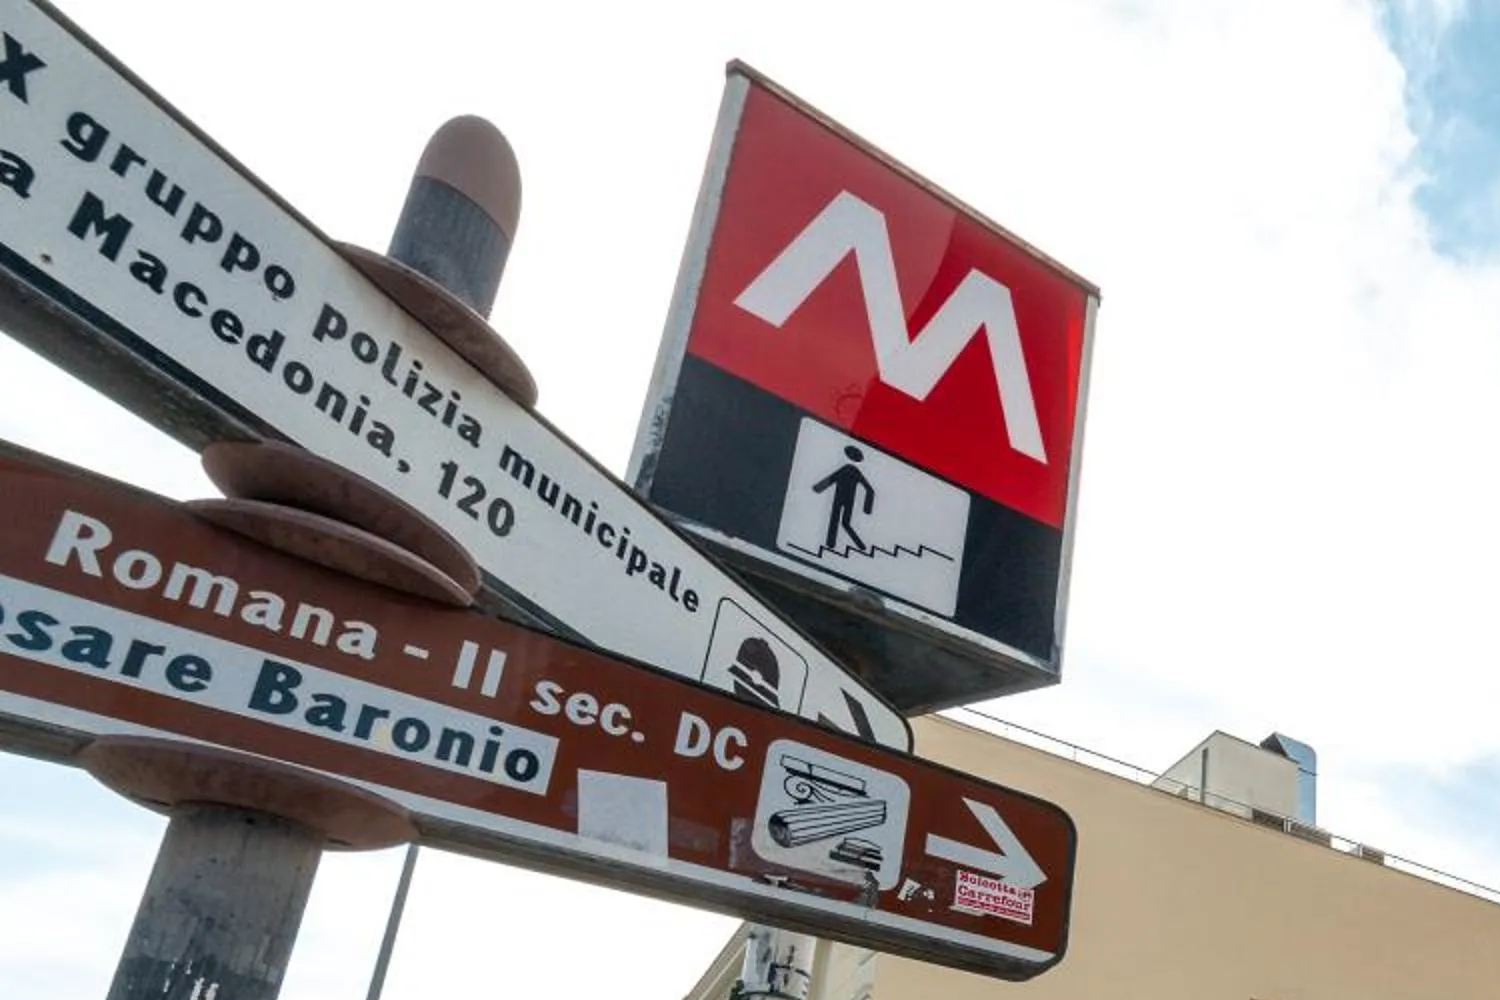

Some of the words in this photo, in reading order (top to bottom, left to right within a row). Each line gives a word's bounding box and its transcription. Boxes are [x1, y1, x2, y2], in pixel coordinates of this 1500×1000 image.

[60, 111, 295, 300] gruppo
[312, 303, 482, 448] polizia
[498, 444, 699, 612] municipale
[67, 191, 411, 474] Macedonia,
[438, 460, 515, 538] 120
[733, 189, 1048, 465] M
[0, 604, 213, 693] sare
[248, 658, 540, 782] Baronio
[45, 509, 379, 660] Romana
[529, 679, 645, 743] sec.
[674, 711, 748, 771] DC
[958, 885, 1031, 911] Carrefour
